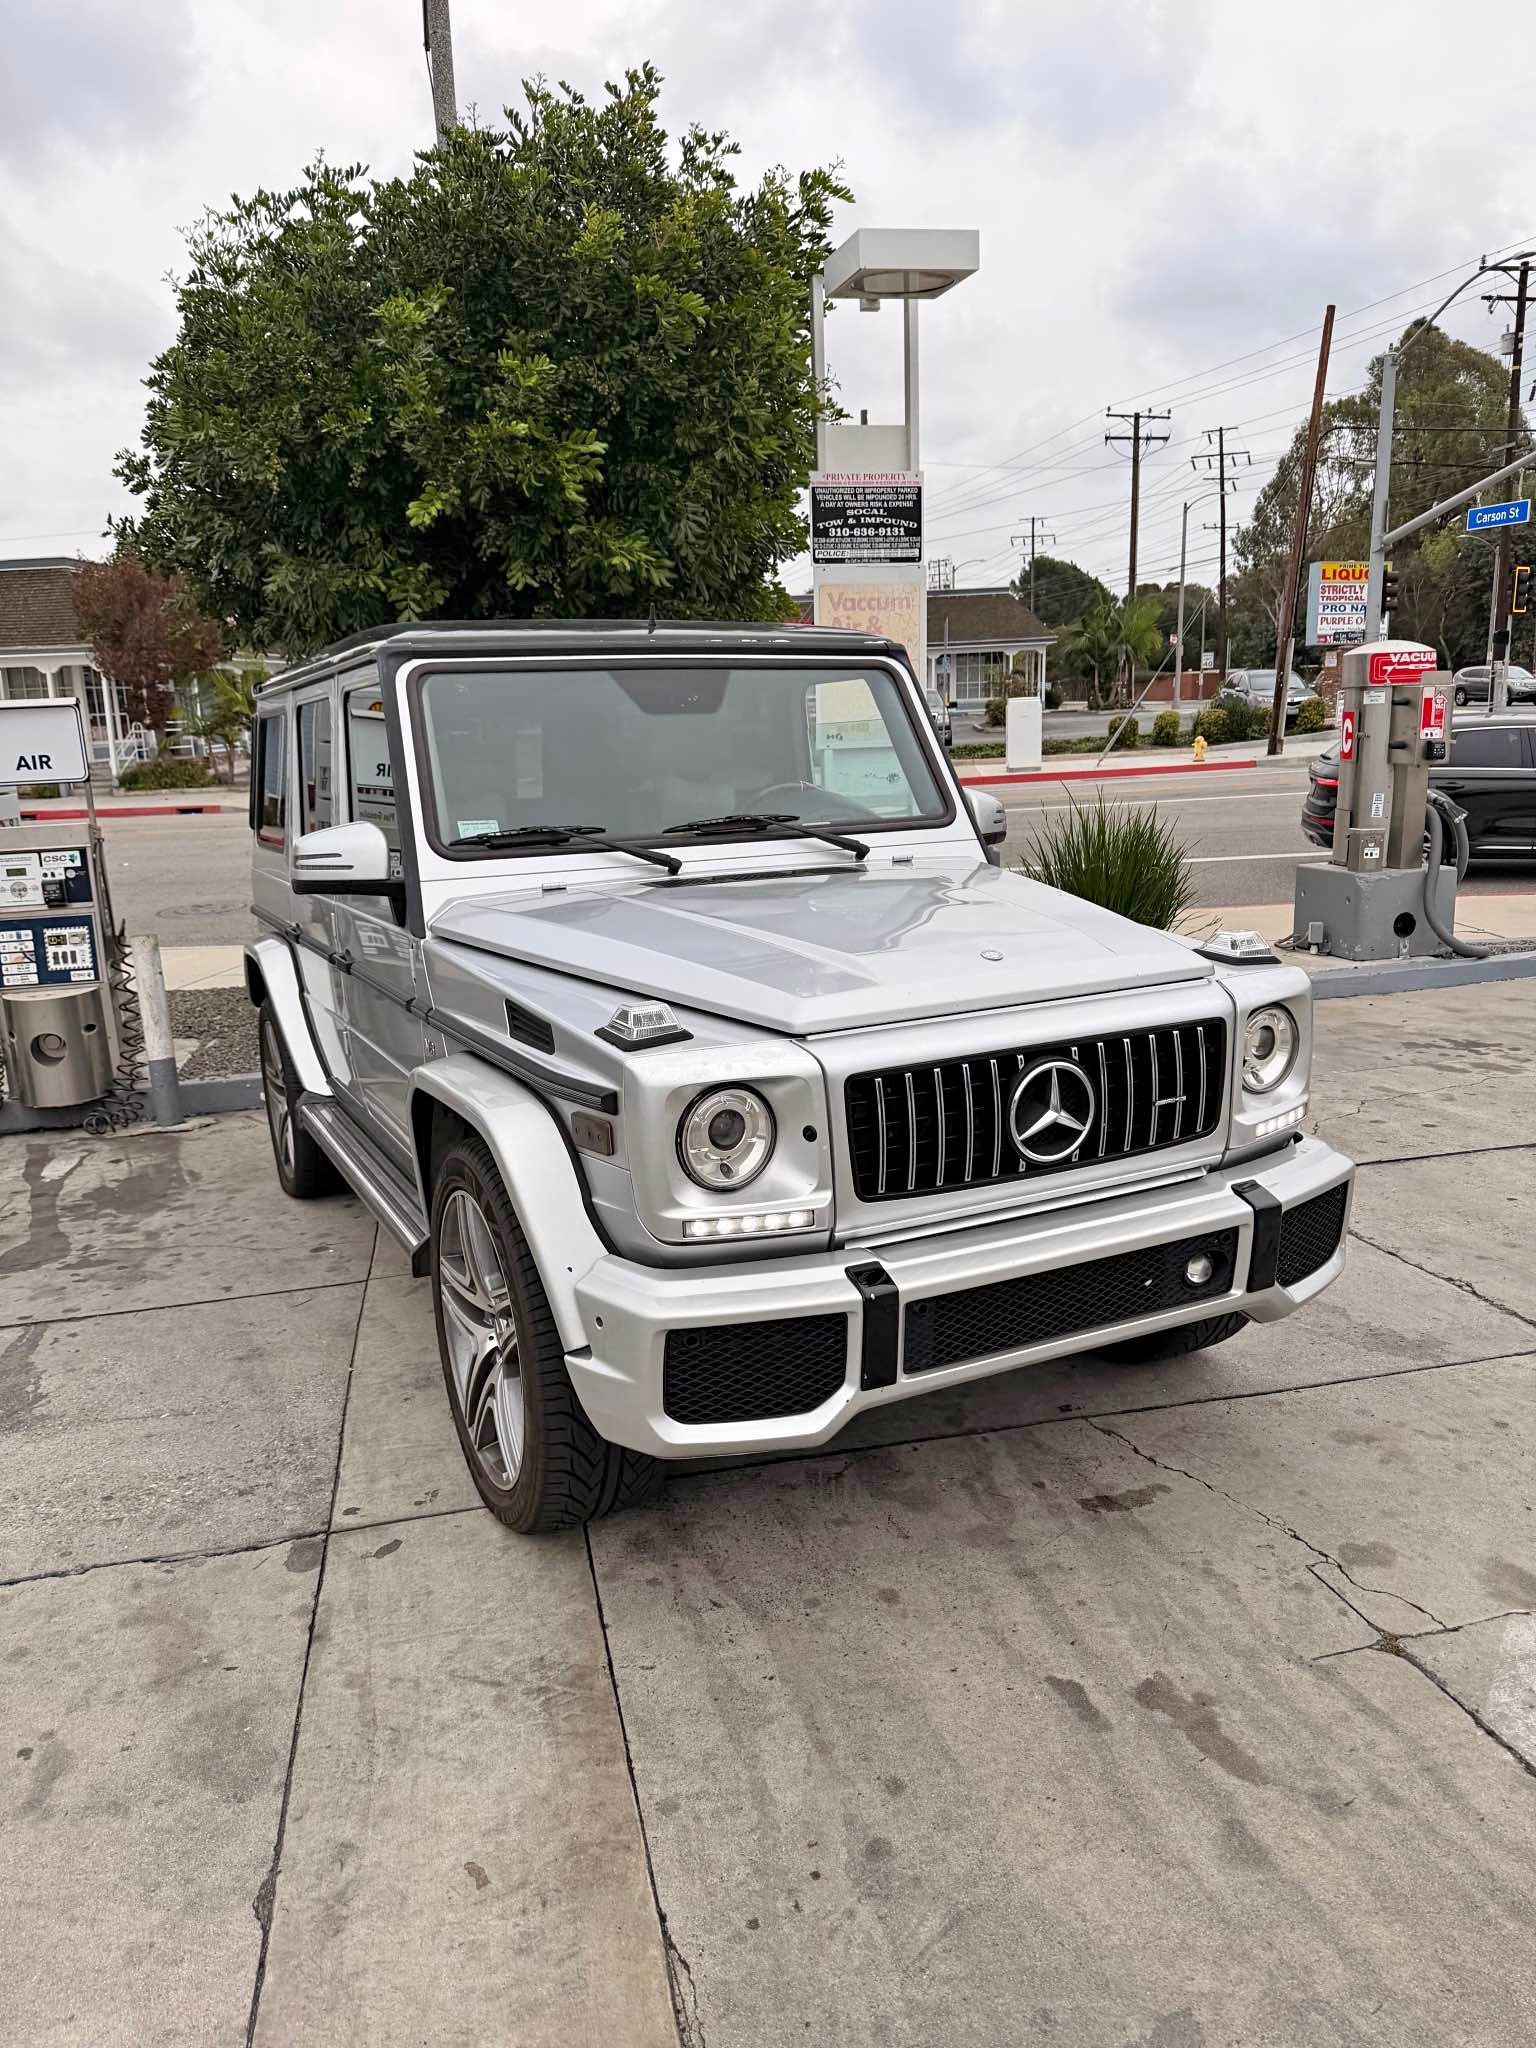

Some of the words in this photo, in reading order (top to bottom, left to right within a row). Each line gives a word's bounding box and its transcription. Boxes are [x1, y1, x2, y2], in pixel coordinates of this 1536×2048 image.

[846, 508, 888, 516] SOCAL
[1476, 511, 1506, 524] Carson
[1508, 506, 1520, 519] St
[816, 518, 844, 530] TOW
[860, 517, 918, 529] IMPOUND
[828, 527, 906, 537] 310-636-9131
[816, 549, 849, 557] POLICE:
[1320, 584, 1366, 595] STRICTLY
[1322, 604, 1346, 612] PRO
[1320, 616, 1353, 626] PURPLE
[16, 754, 53, 771] AIR
[43, 854, 68, 862] CSC
